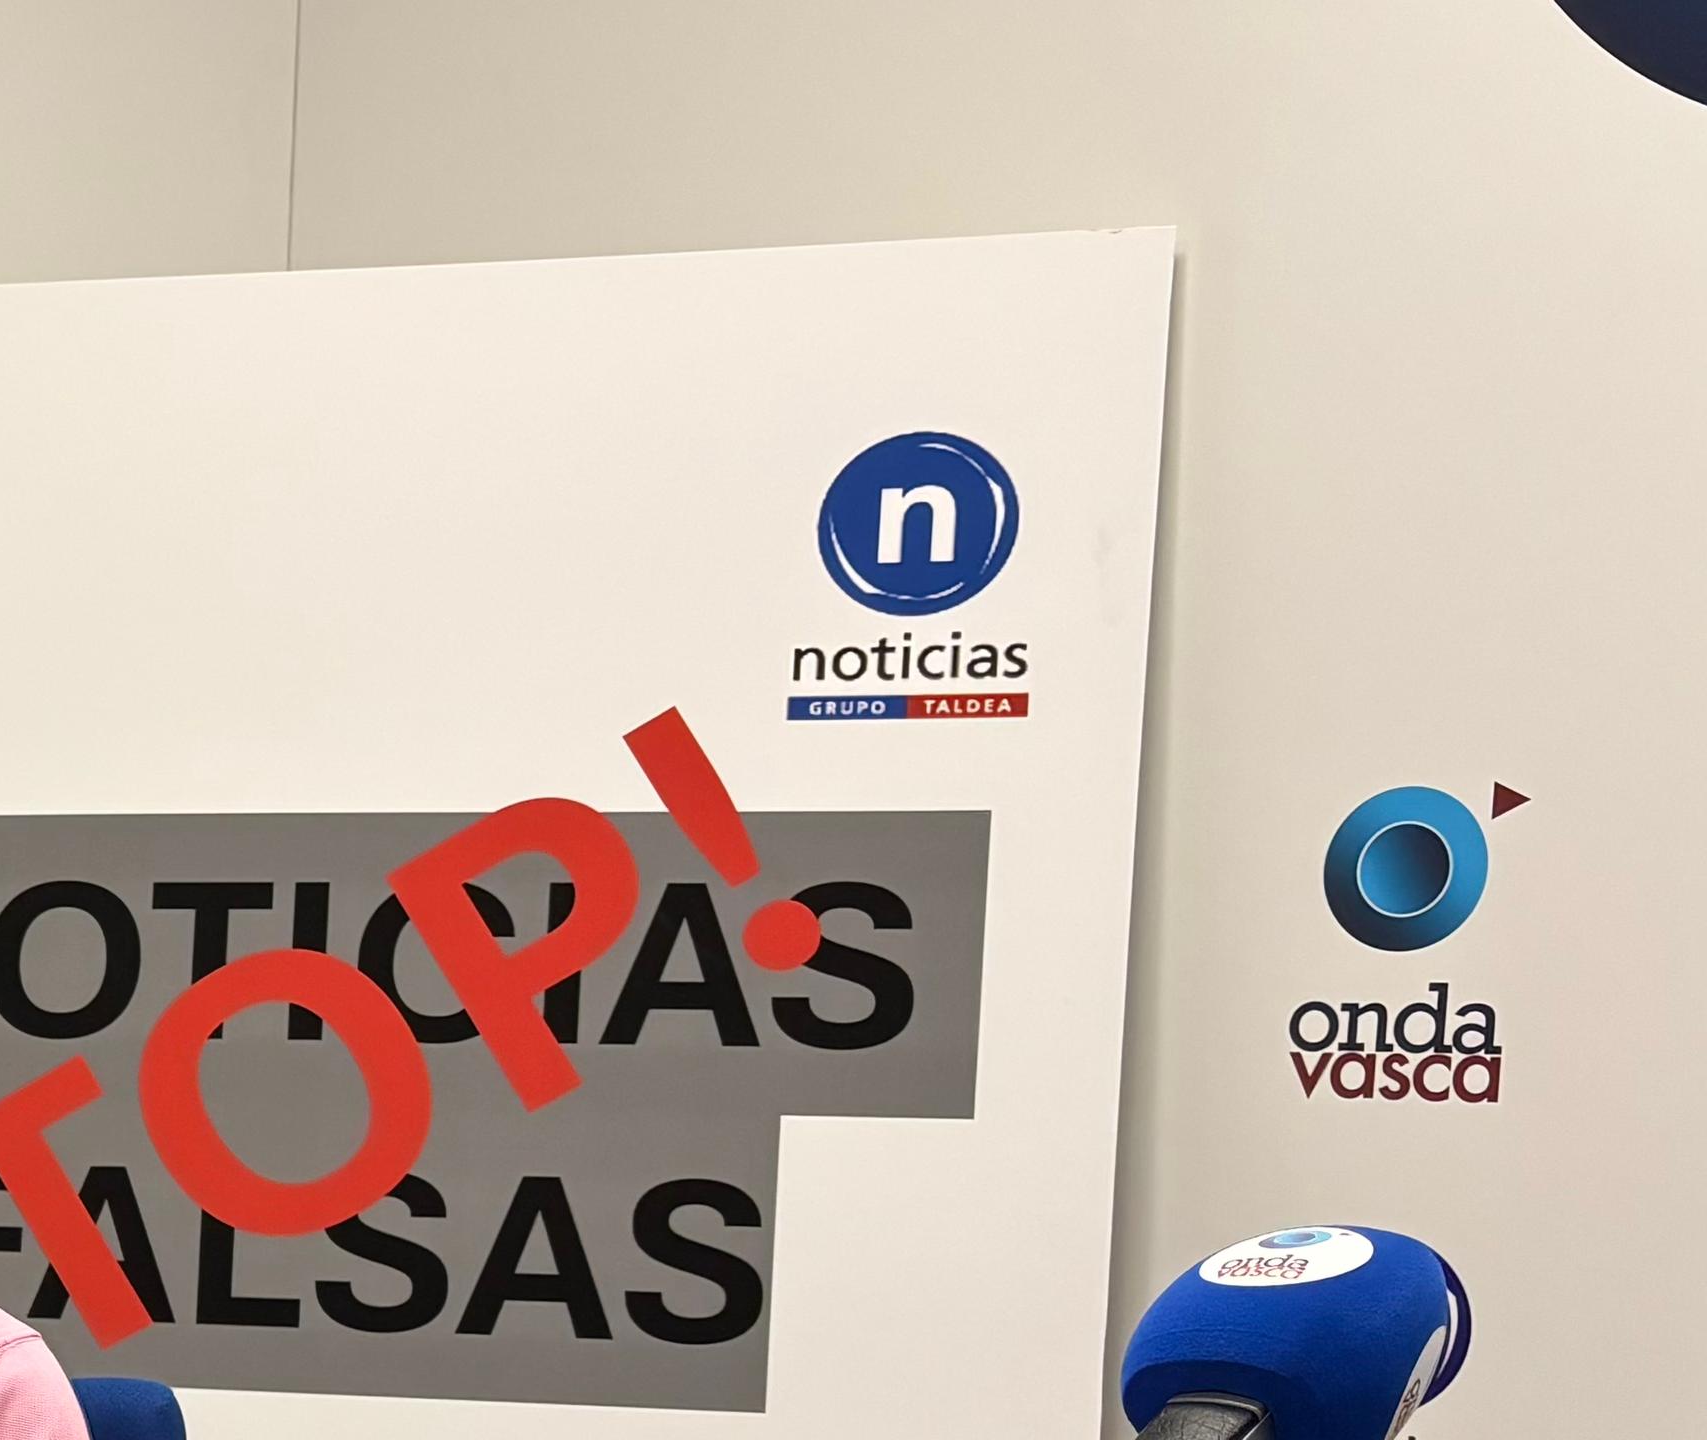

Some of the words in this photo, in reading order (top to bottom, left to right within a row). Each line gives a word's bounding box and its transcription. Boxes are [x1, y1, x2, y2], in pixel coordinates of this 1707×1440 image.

[878, 476, 957, 566] n
[792, 632, 1028, 685] noticias
[809, 698, 887, 717] GRUPO
[924, 695, 1012, 717] TALDEA
[1288, 982, 1502, 1057] onda
[1289, 1048, 1501, 1104] vasca
[1221, 1254, 1309, 1270] onda
